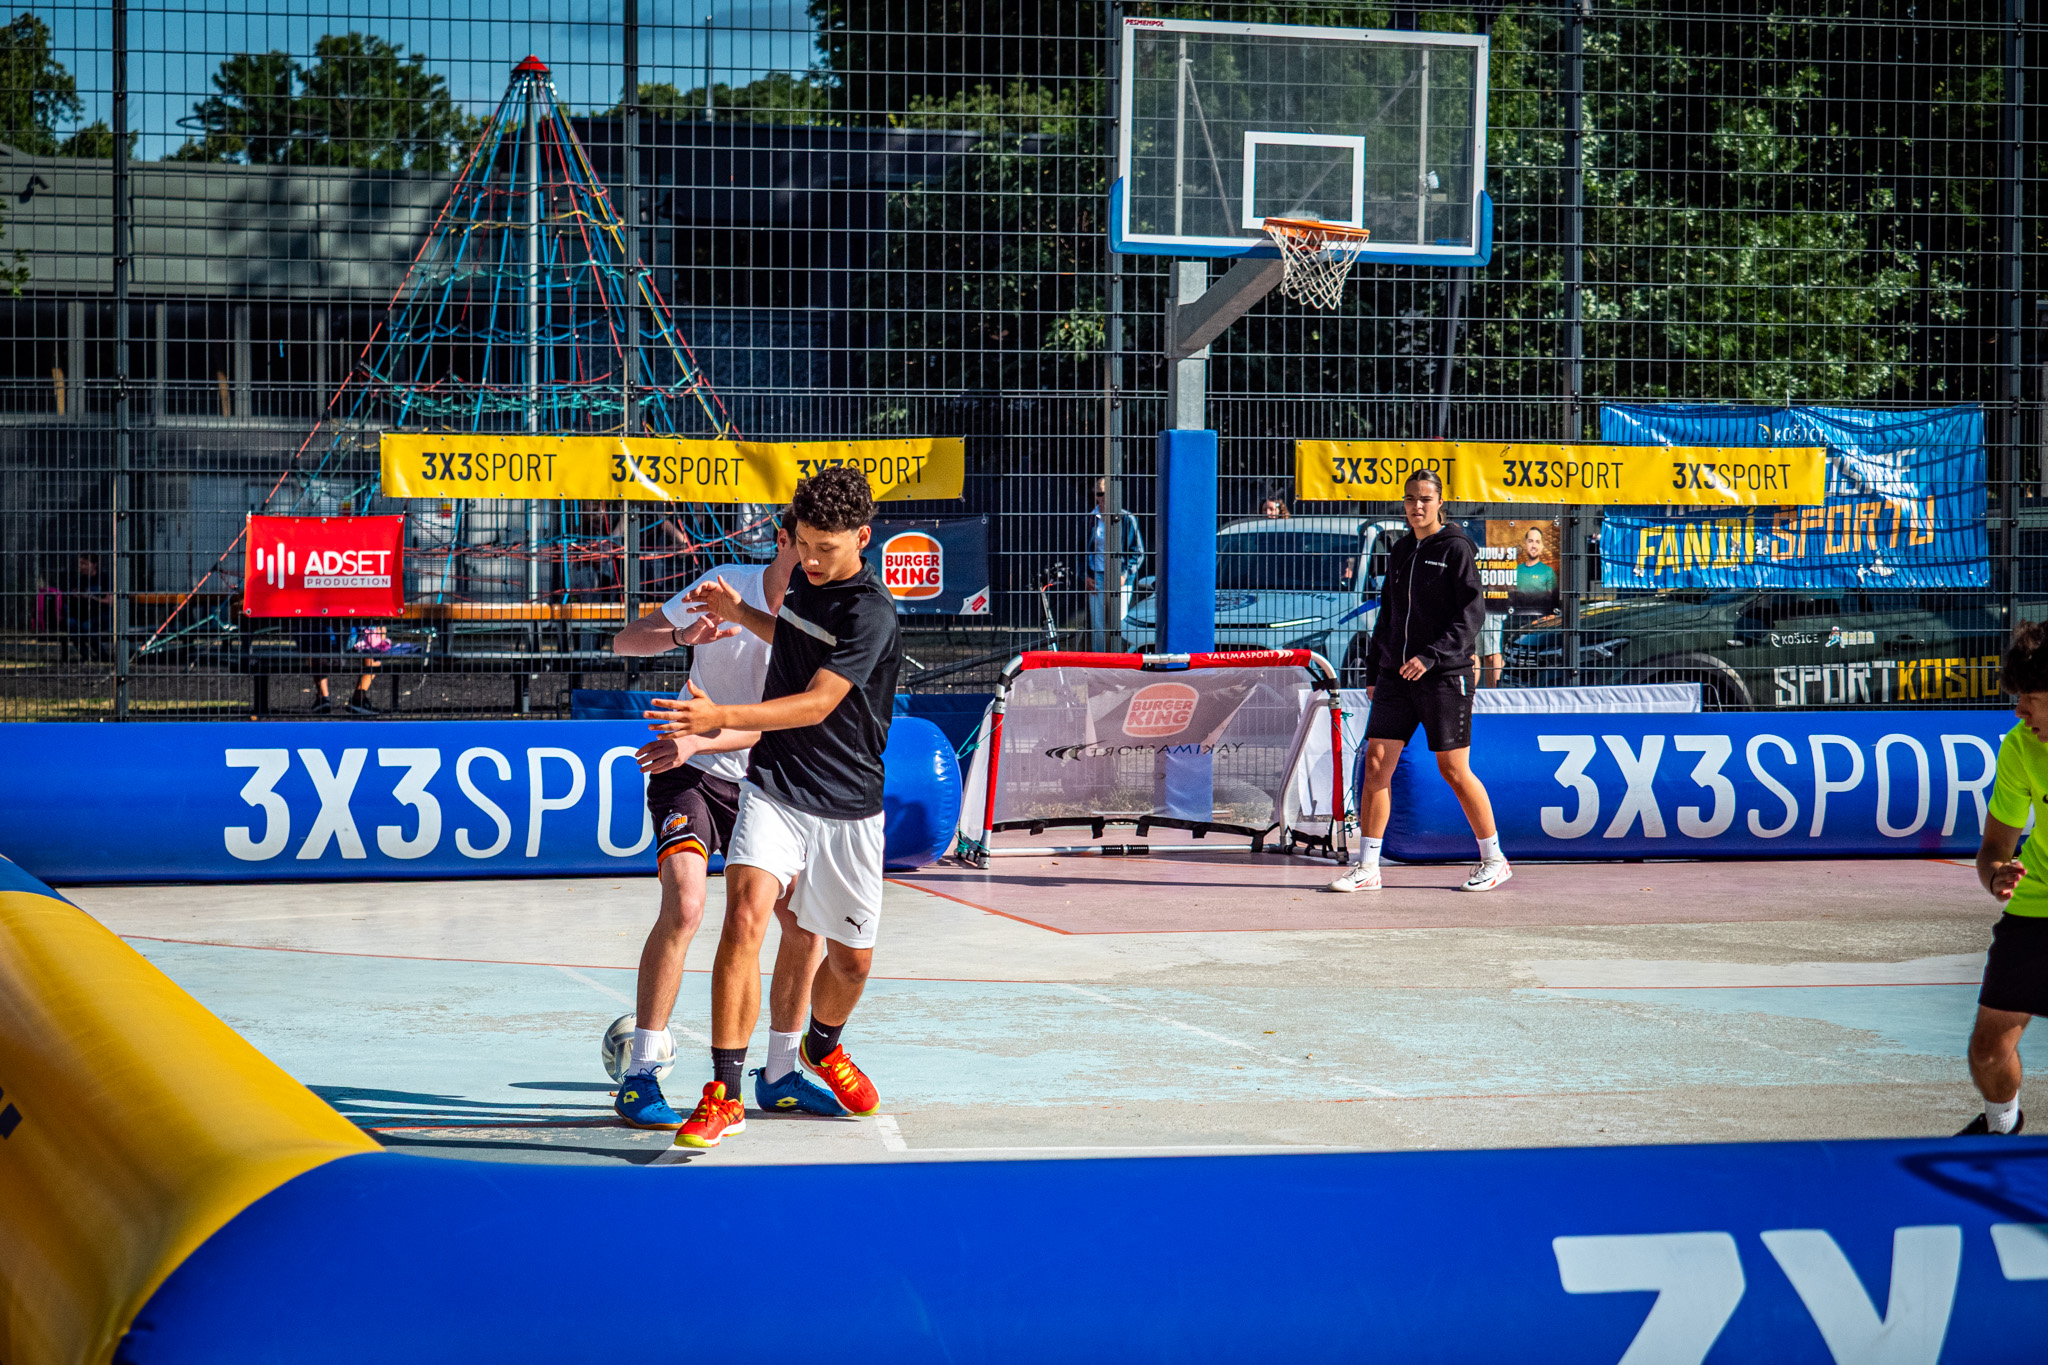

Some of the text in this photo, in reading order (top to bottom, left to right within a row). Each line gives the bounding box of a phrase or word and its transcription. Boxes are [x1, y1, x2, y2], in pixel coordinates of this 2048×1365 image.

[421, 452, 557, 482] 3X3SPORT
[611, 454, 744, 486] 3X3SPORT
[1503, 460, 1624, 489] 3X3SPORT
[1672, 462, 1791, 490] 3X3SPORT
[304, 550, 391, 575] ADSET
[885, 554, 940, 567] BURGER
[306, 577, 389, 586] PRODUCTION
[885, 567, 940, 585] KING
[1478, 569, 1517, 585] BODU!
[1207, 650, 1275, 660] YAKIMASPORT
[1131, 700, 1194, 711] BURGER
[1127, 710, 1190, 726] KING
[1537, 733, 2035, 839] 3X3SPOR
[224, 746, 656, 861] 3X3SPO
